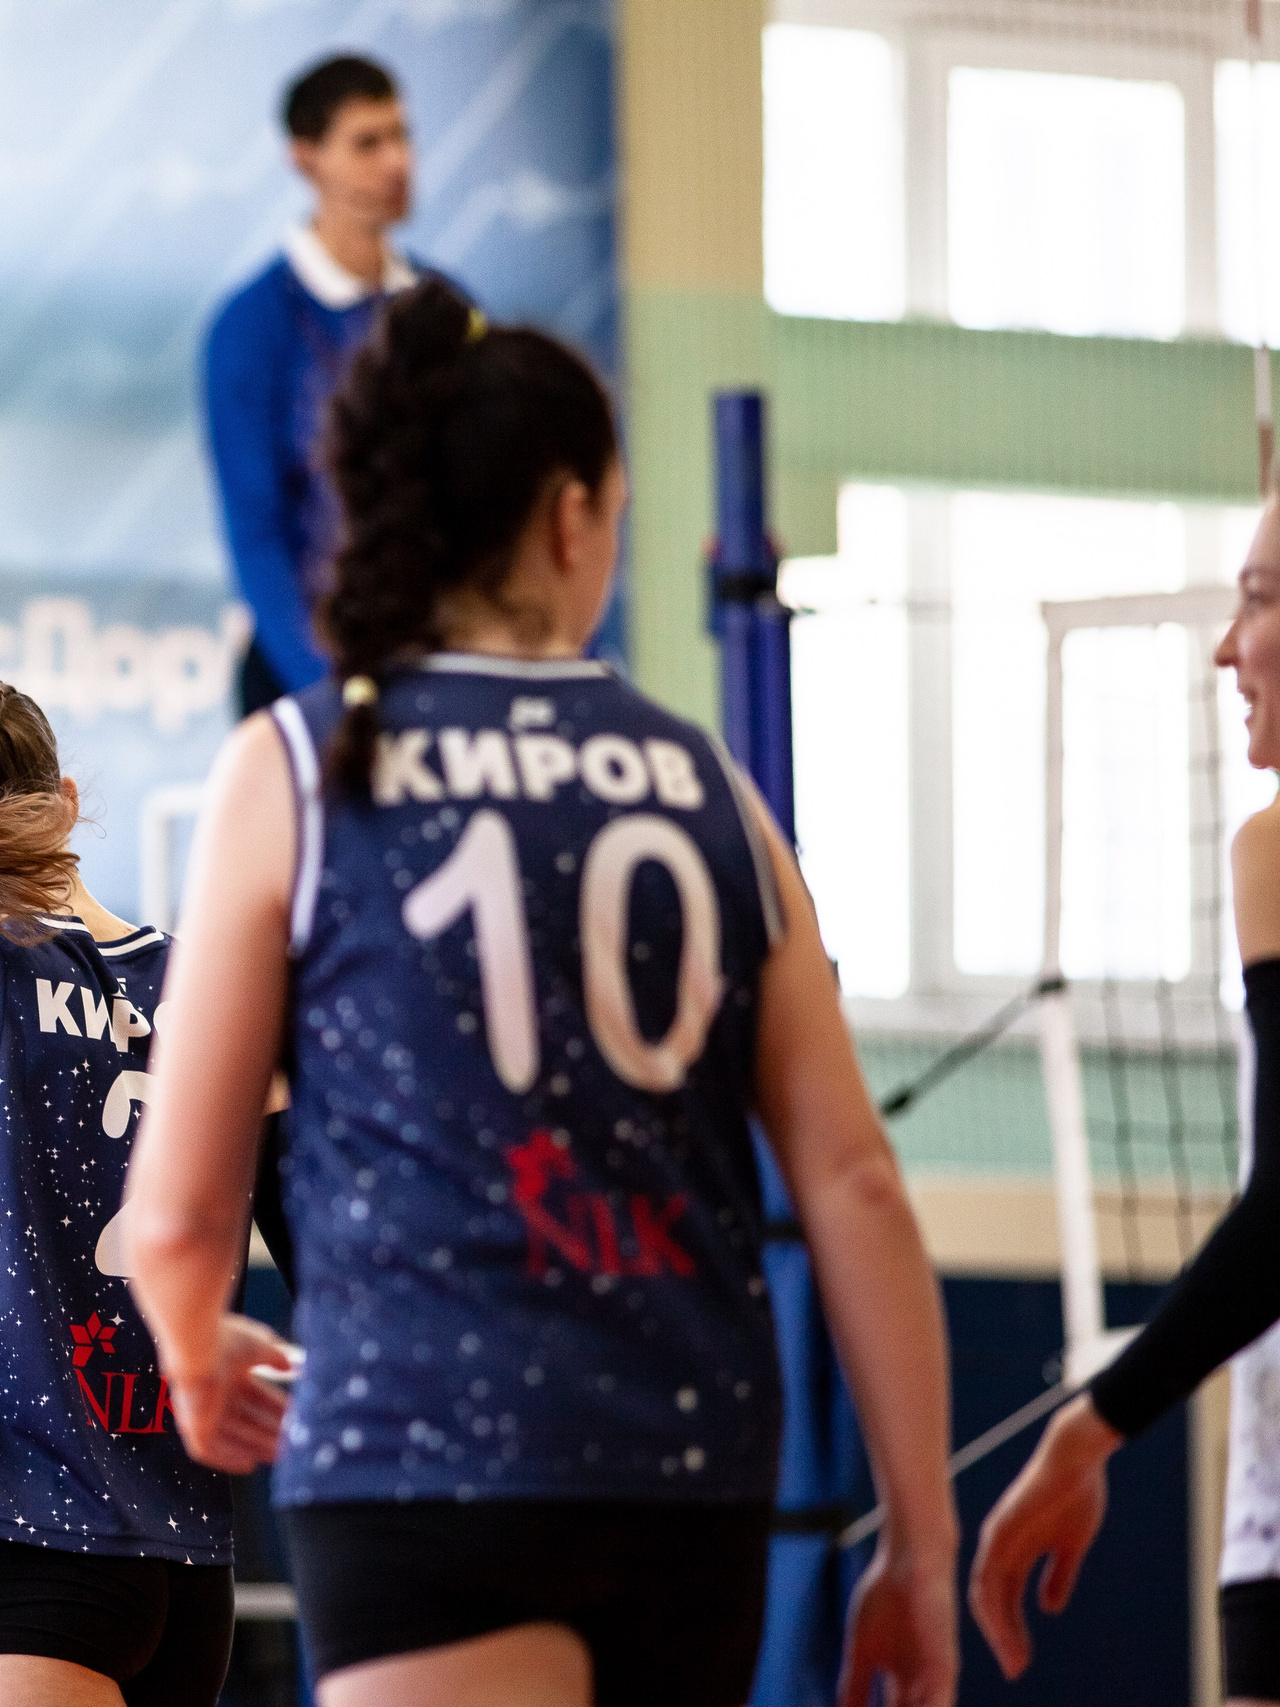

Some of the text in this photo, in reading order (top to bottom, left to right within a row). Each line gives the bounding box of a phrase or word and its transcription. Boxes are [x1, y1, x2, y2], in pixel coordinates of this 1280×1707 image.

[371, 727, 706, 811] КИРОВ
[402, 808, 721, 1094] 10
[517, 1194, 697, 1278] NLK
